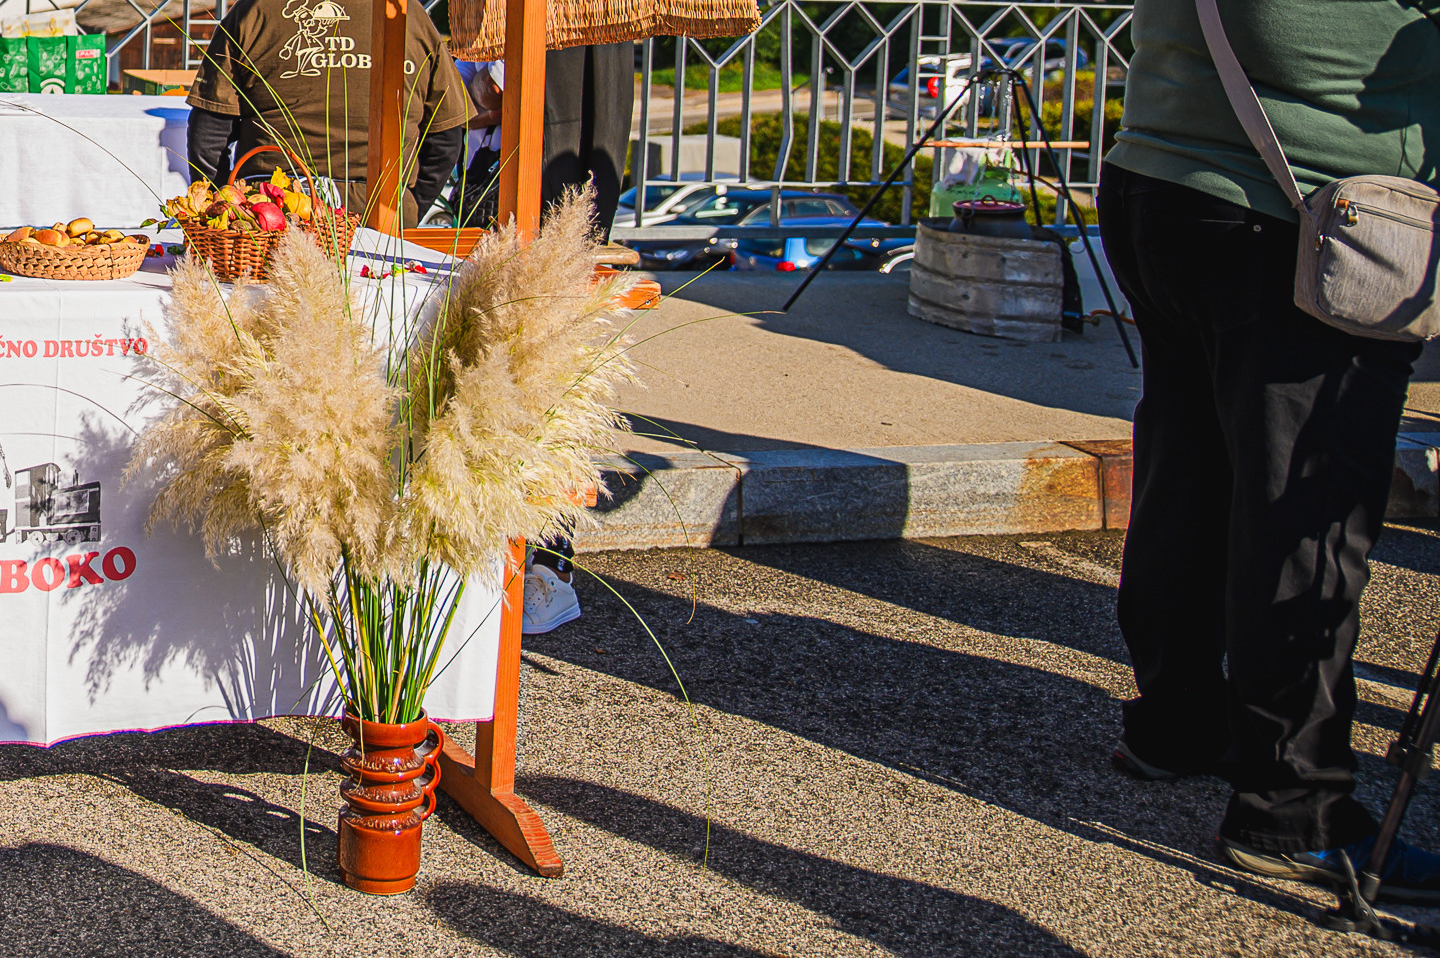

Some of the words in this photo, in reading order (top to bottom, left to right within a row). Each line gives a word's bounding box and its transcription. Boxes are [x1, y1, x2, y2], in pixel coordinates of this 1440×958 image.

[324, 36, 356, 52] TD
[310, 52, 416, 75] GLOBO
[42, 333, 149, 359] DRUŠTVO
